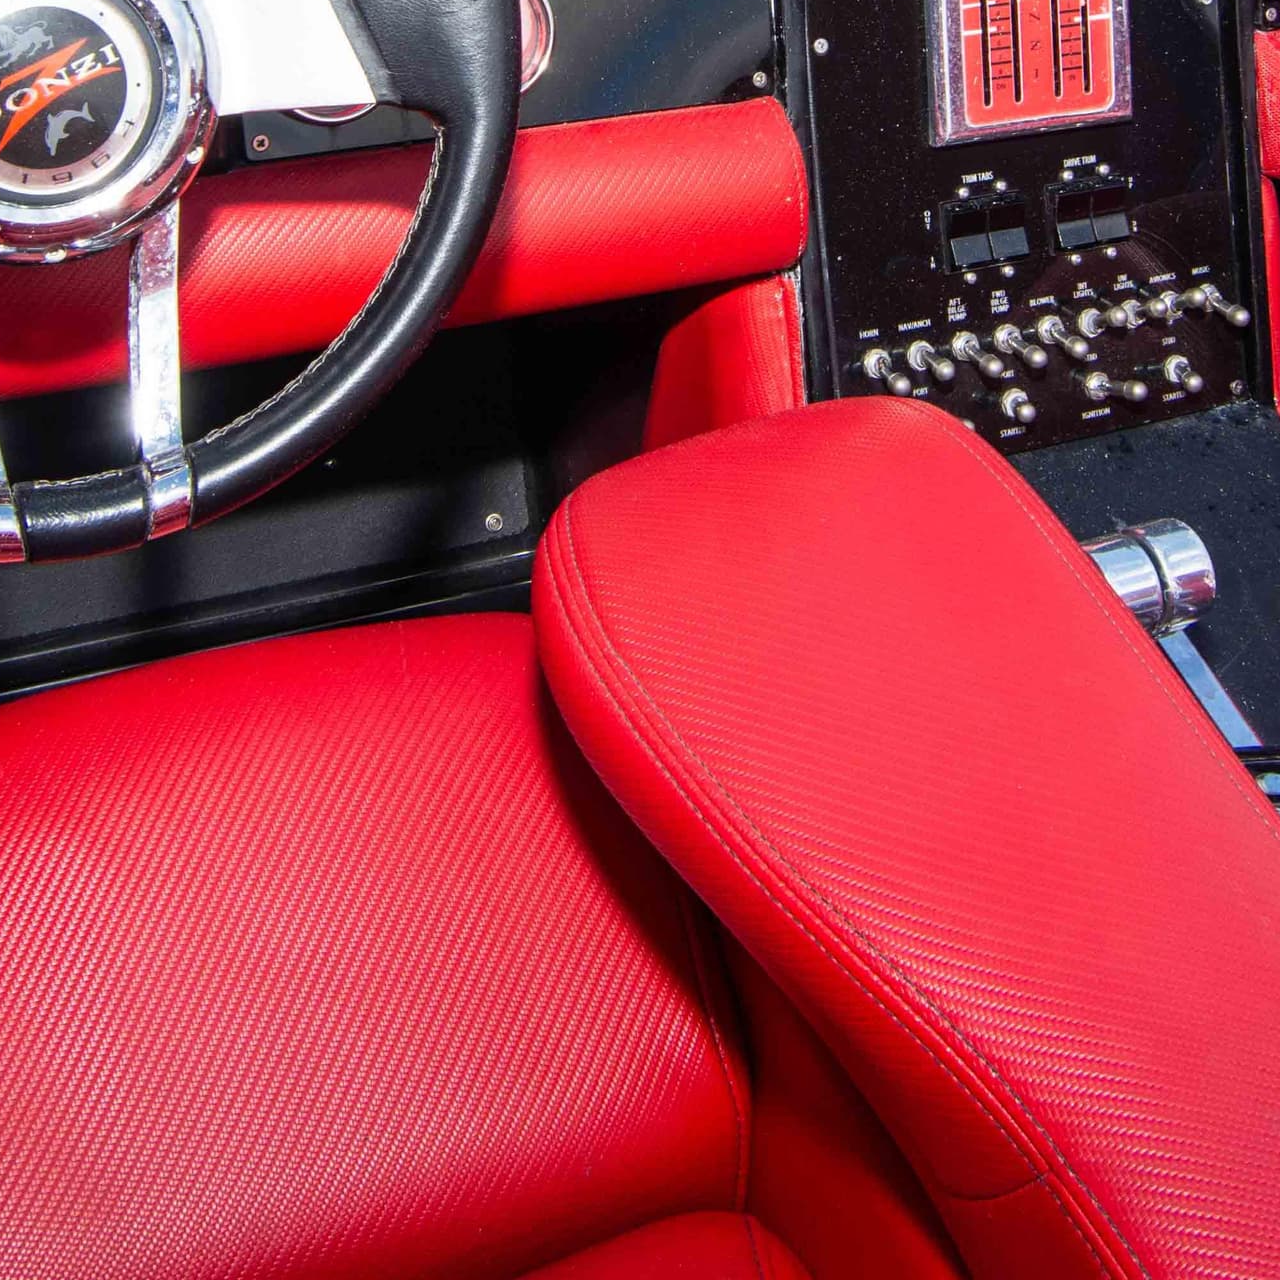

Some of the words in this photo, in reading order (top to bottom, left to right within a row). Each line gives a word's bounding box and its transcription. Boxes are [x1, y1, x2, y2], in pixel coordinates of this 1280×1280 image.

[1082, 154, 1097, 165] TRIM
[961, 173, 978, 184] TRIM
[978, 170, 994, 182] TABS
[1113, 280, 1135, 291] LIGHTS
[1073, 288, 1095, 299] LIGHTS
[949, 298, 961, 306] AFT
[991, 297, 1009, 307] BILGE
[1029, 295, 1055, 308] BLOWER
[948, 304, 967, 314] BILGE
[991, 304, 1010, 315] PUMP
[948, 312, 968, 322] PUMP
[859, 328, 879, 339] HORN
[1081, 407, 1111, 419] IGNITION
